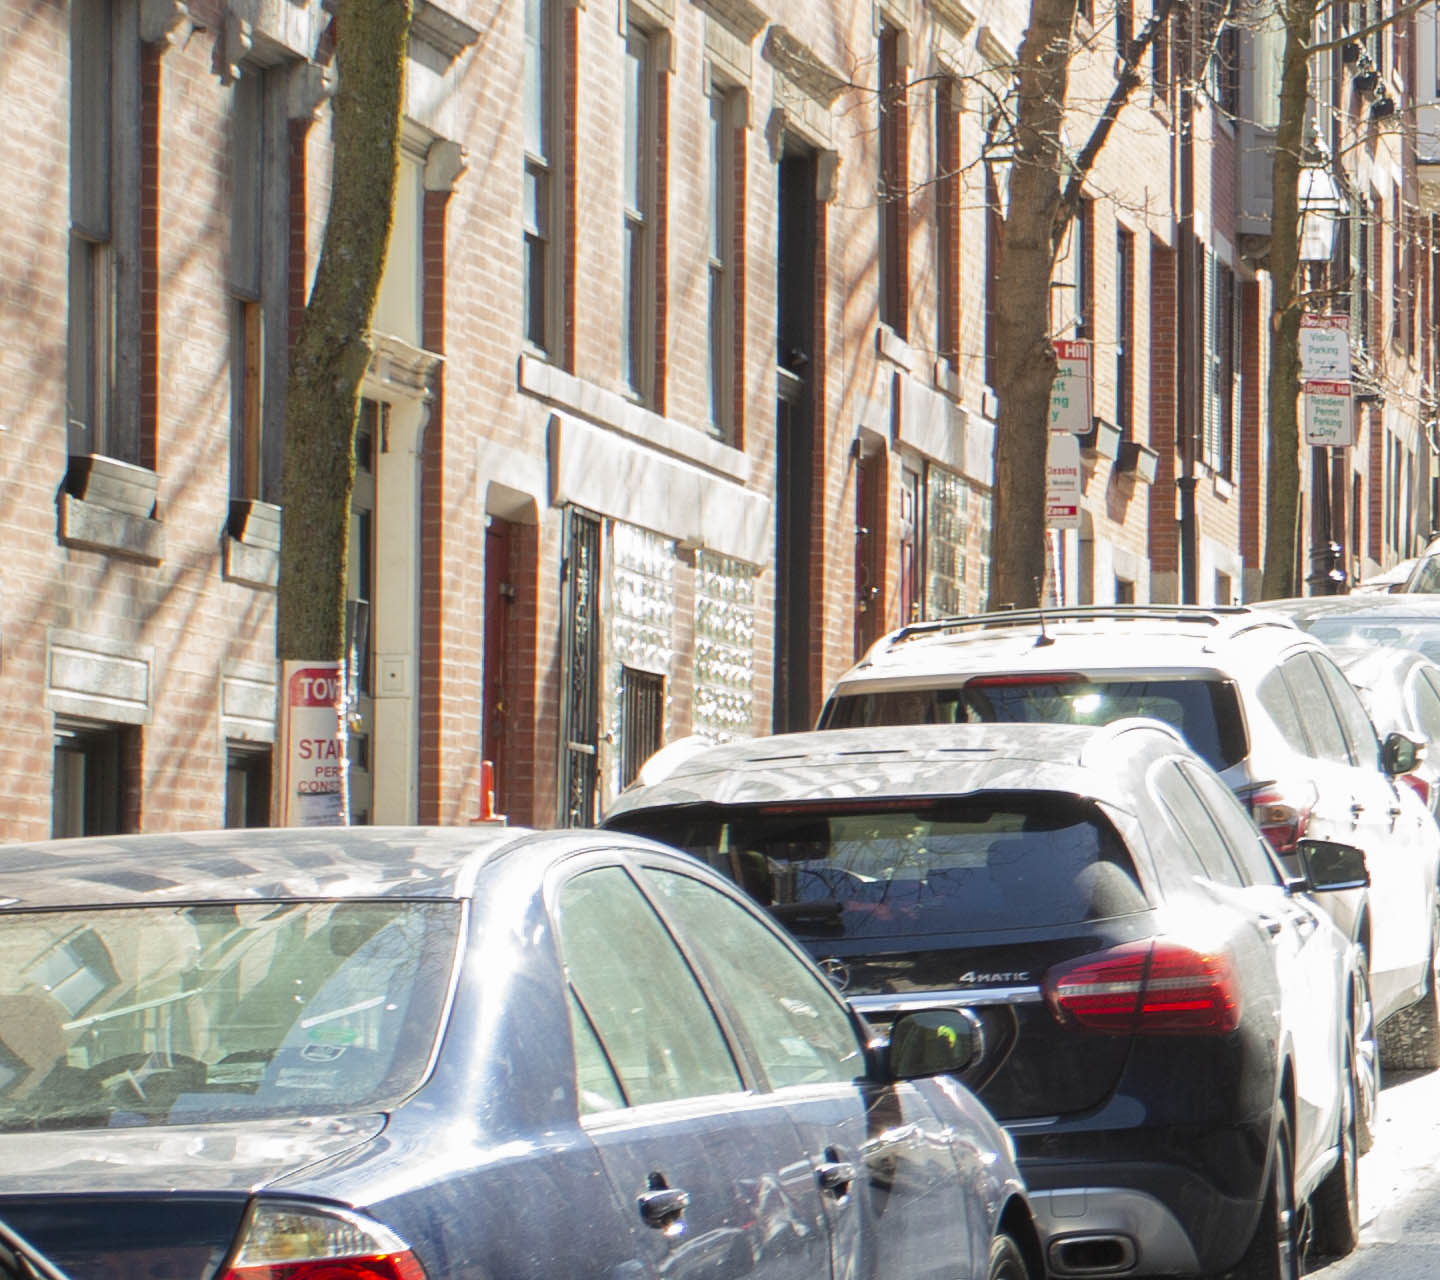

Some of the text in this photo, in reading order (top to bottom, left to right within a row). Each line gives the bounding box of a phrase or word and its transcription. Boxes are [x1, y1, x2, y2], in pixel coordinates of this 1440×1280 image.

[1065, 344, 1089, 359] Hill
[315, 766, 339, 778] PER
[959, 971, 1031, 983] 4MATIC
